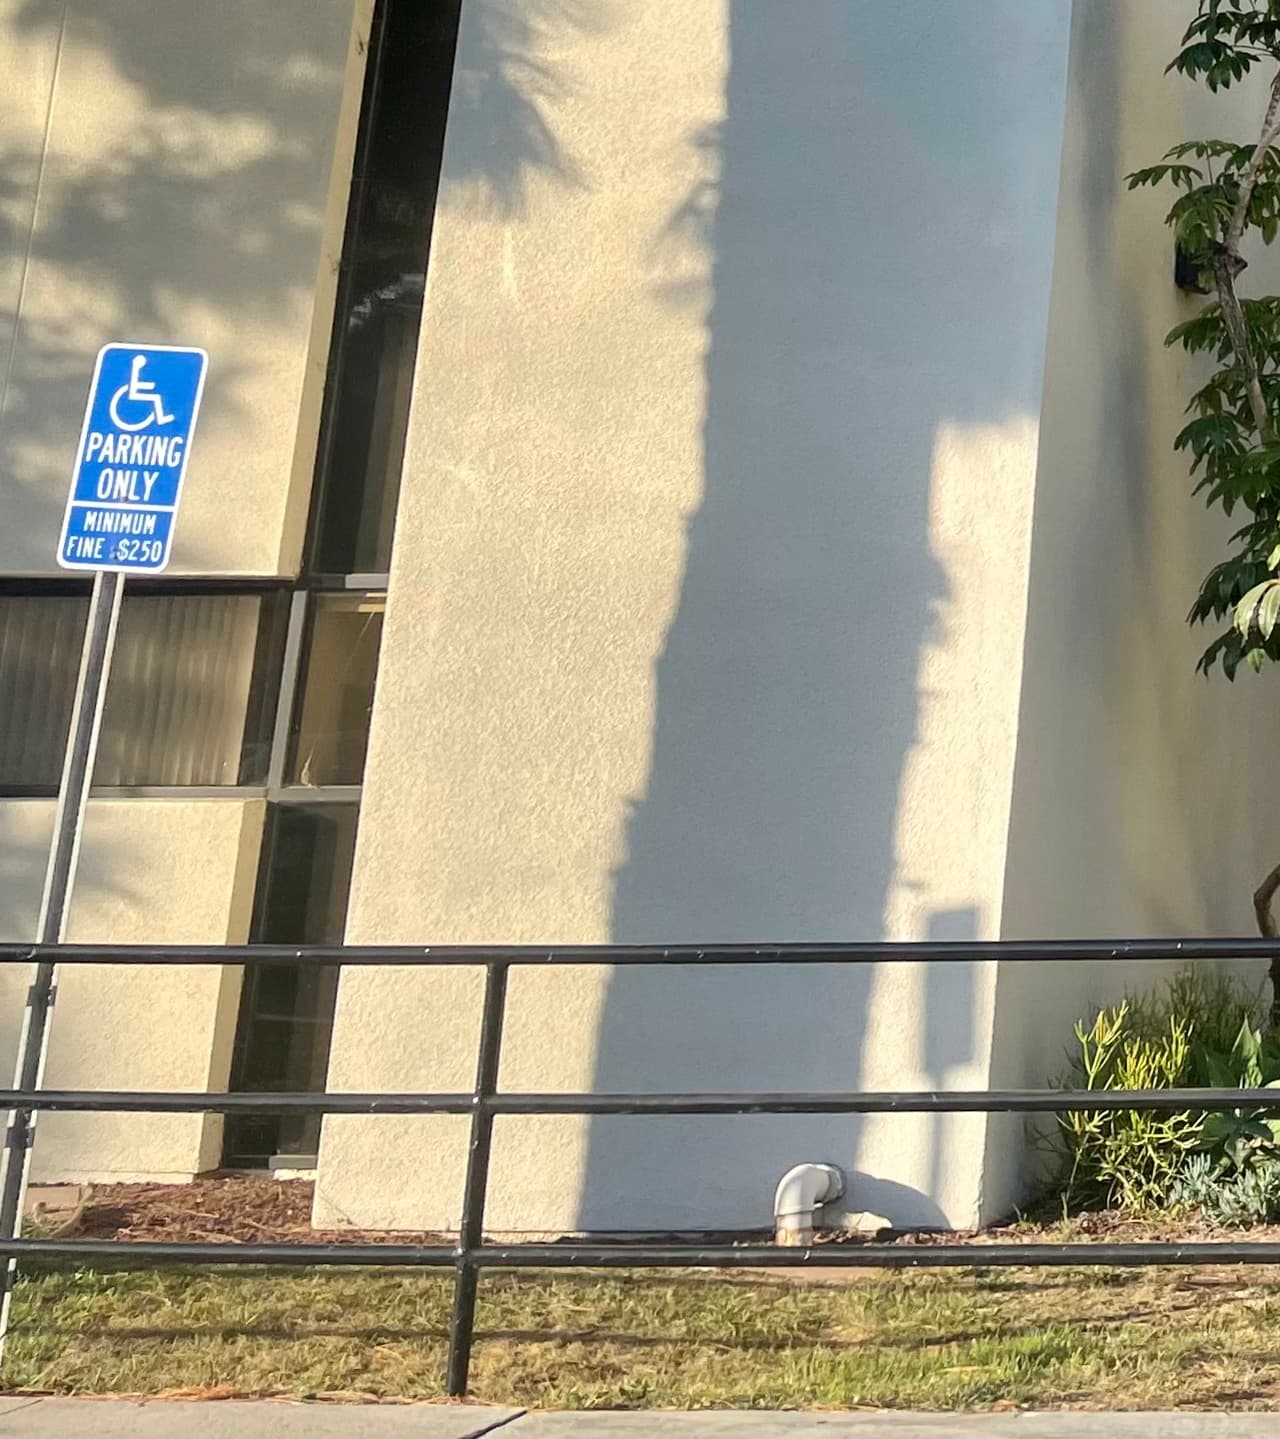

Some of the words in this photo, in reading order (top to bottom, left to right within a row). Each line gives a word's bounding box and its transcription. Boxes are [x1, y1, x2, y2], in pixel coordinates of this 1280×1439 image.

[86, 432, 184, 467] PARKING
[97, 468, 159, 502] ONLY
[83, 510, 157, 535] MINIMUM
[66, 535, 106, 559] FINE
[116, 538, 163, 562] $250
